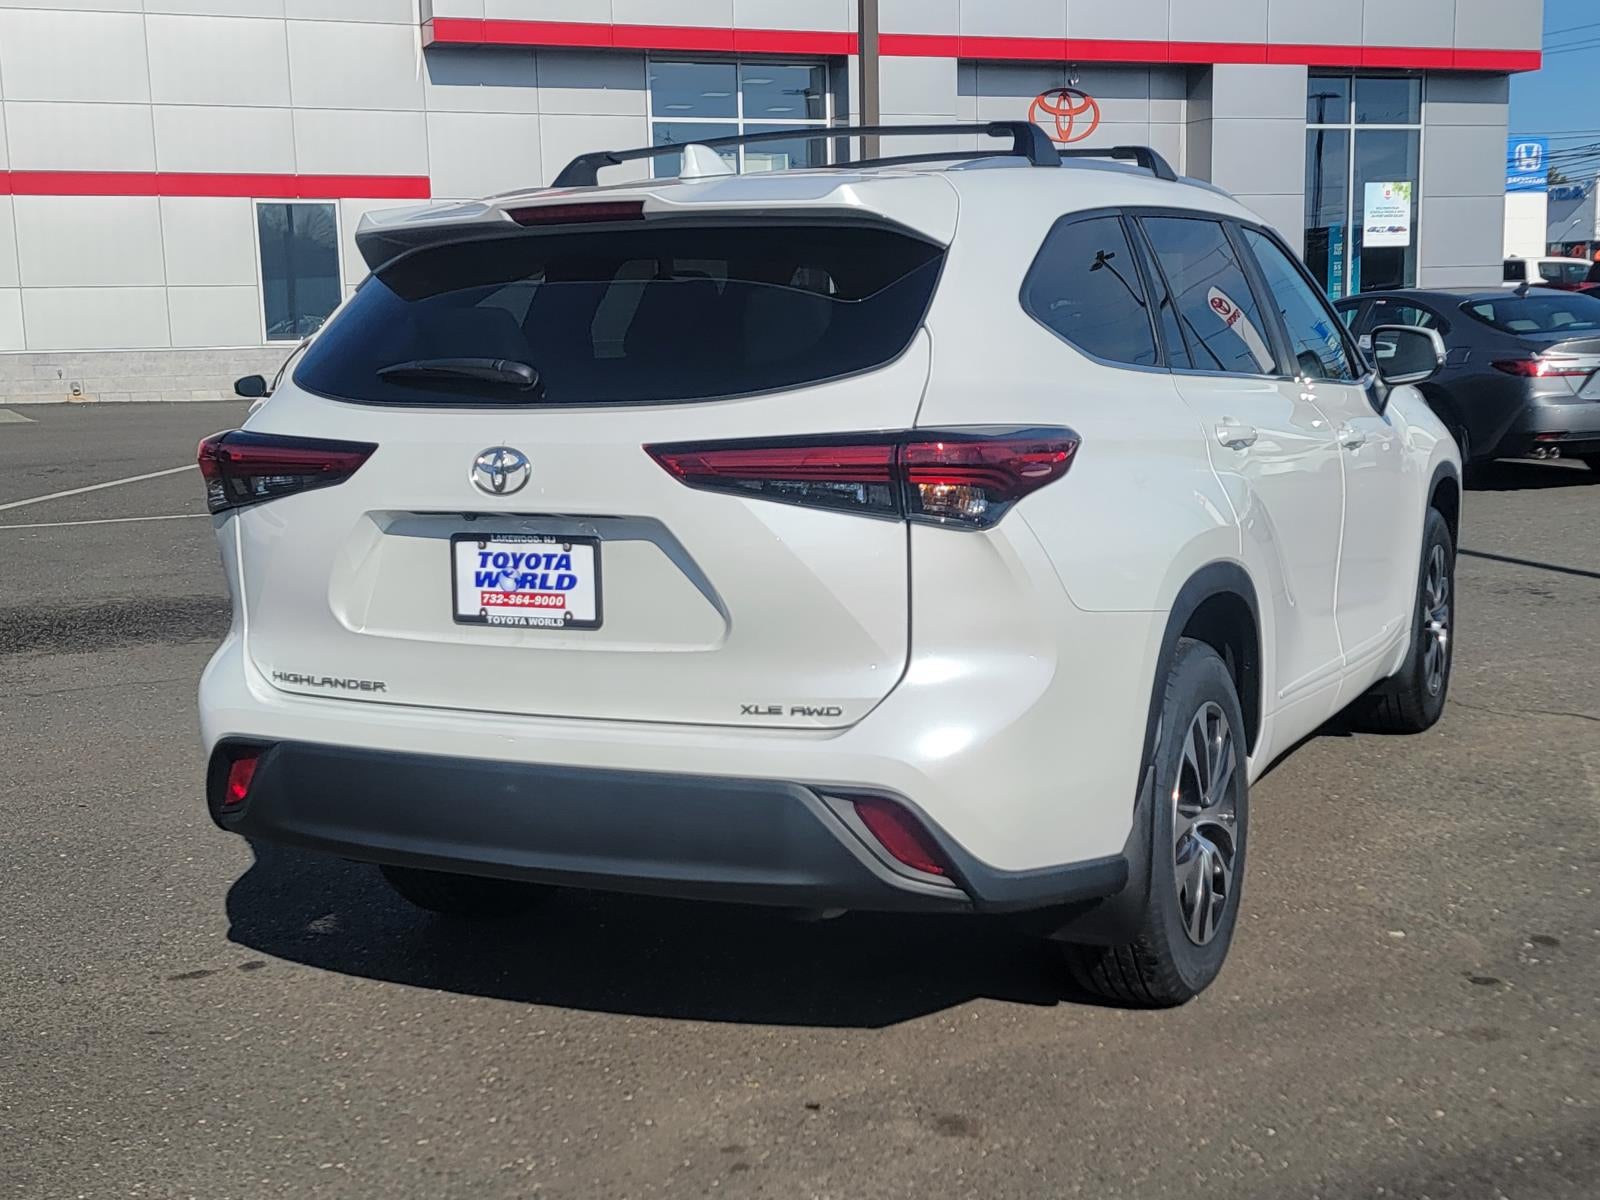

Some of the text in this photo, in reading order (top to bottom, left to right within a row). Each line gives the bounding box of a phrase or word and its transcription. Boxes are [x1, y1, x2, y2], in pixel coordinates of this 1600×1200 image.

[543, 535, 556, 544] NJ
[478, 551, 572, 571] TOYOTA
[474, 570, 578, 591] WORLD
[482, 593, 564, 606] 732-364-9000
[486, 615, 565, 627] TOYOTA WORLD
[272, 670, 388, 693] HIGHLANDER
[740, 704, 843, 717] XLE AWD
